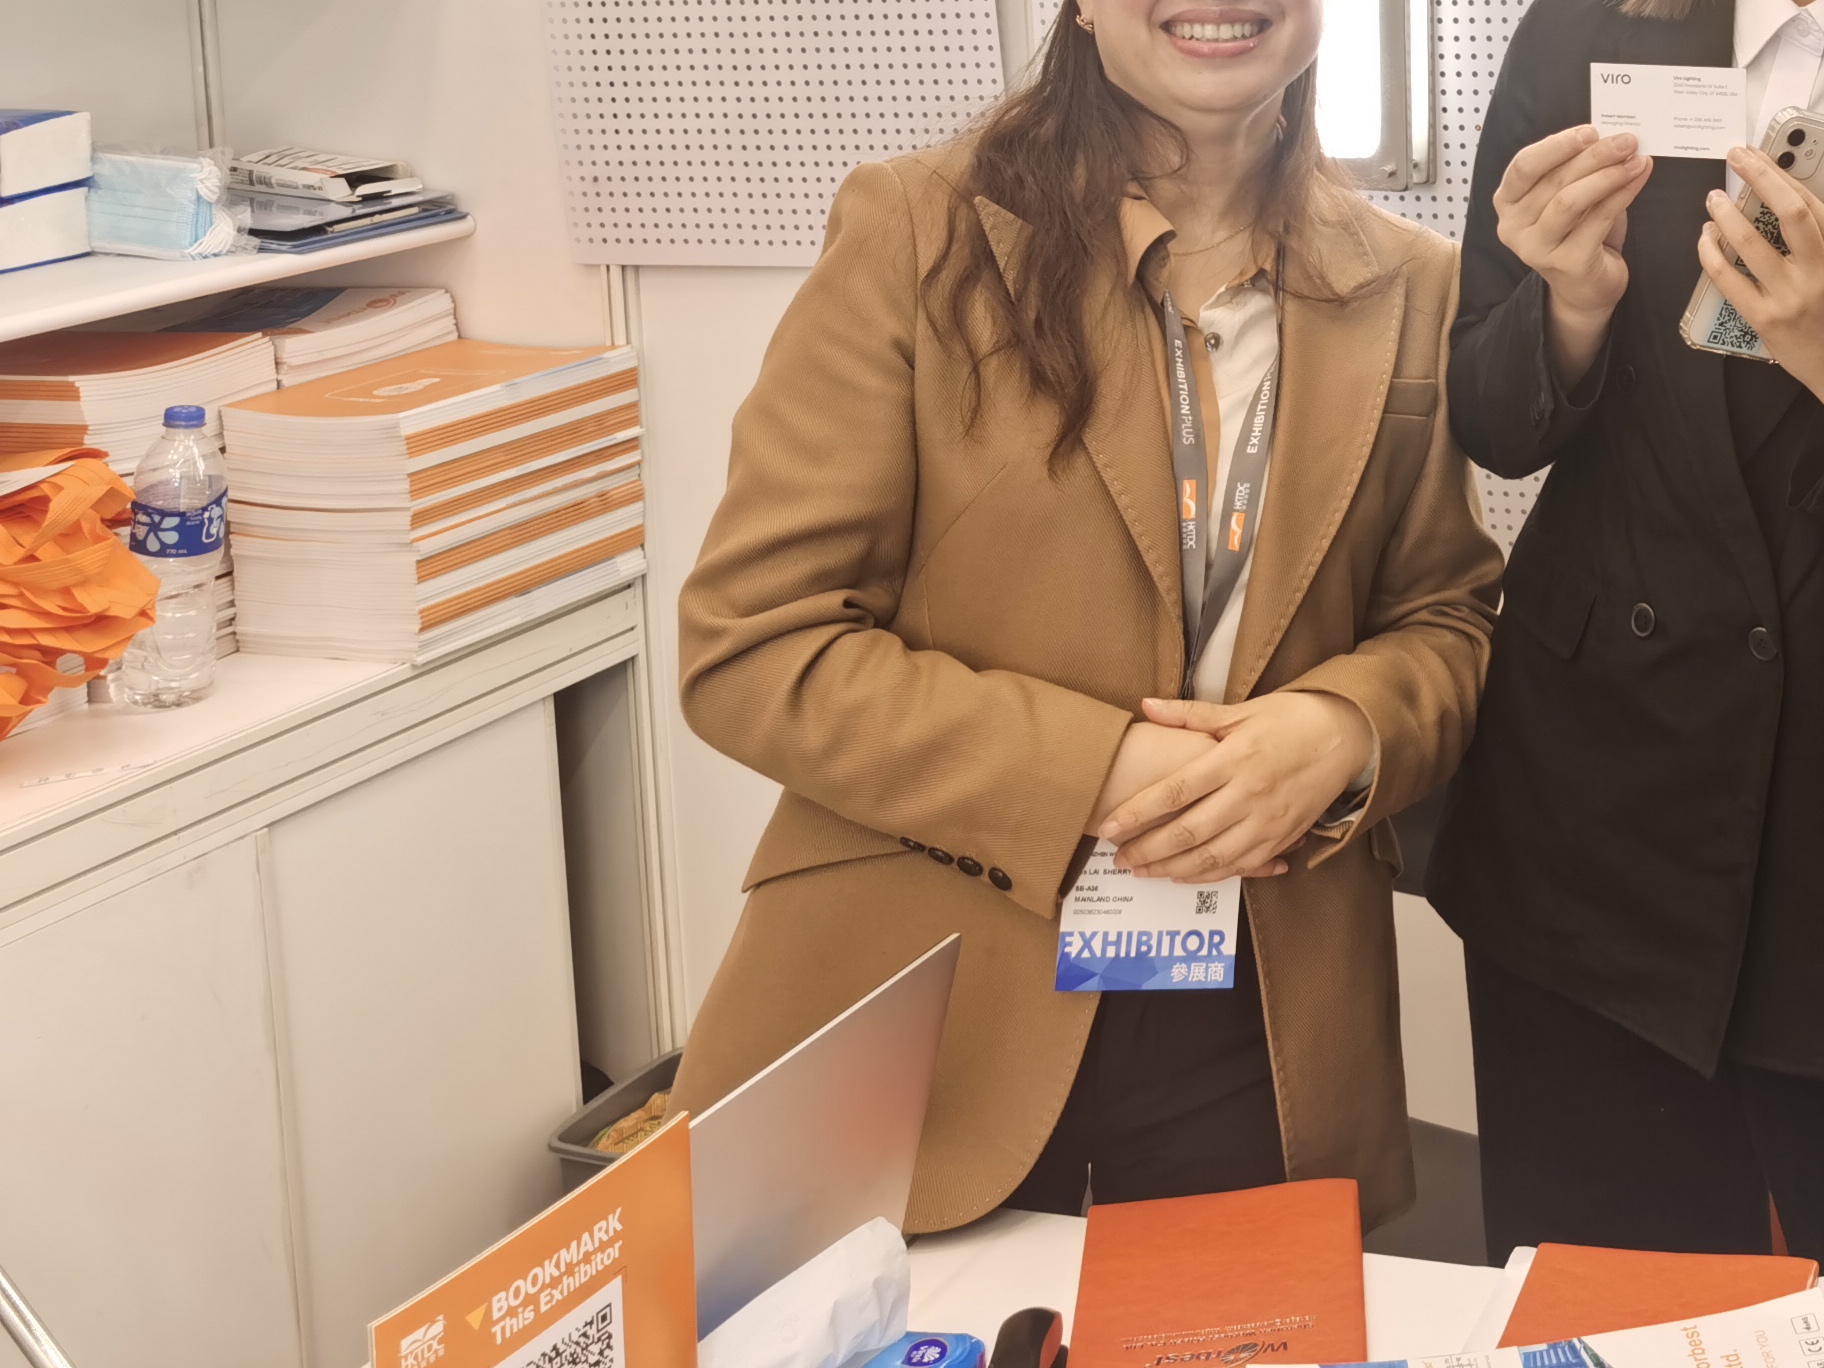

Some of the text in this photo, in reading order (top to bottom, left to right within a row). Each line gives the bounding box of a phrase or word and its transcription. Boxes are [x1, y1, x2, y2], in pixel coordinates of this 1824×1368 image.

[1103, 868, 1132, 876] SHERRY
[1060, 929, 1226, 958] EXHIBITOR
[1171, 962, 1225, 982] 參展商
[491, 1207, 623, 1320] BOOKMARK
[491, 1241, 623, 1345] This Exhibitor
